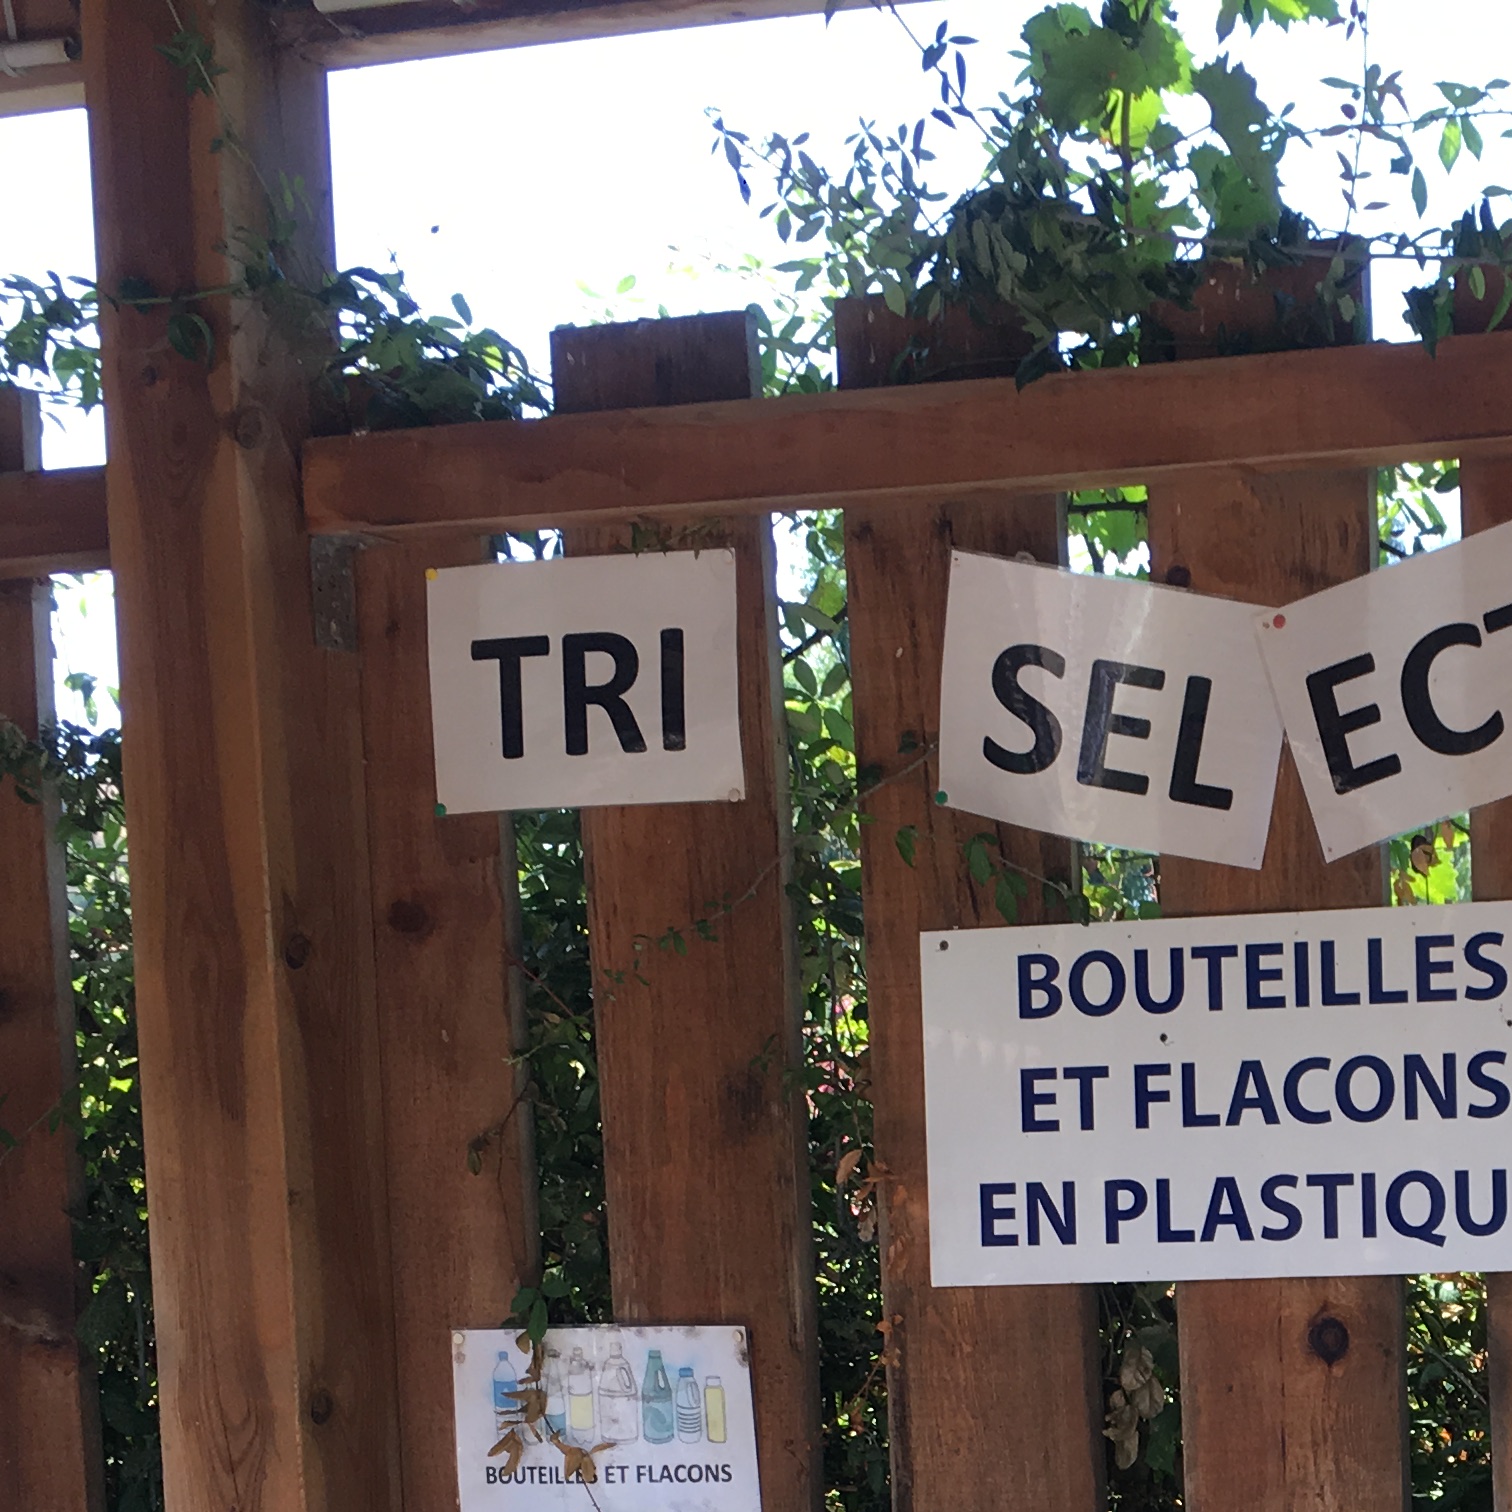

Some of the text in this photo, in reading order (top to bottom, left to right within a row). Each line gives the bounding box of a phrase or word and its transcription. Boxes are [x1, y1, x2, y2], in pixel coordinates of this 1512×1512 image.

[471, 628, 686, 759] TRI
[1017, 931, 1508, 1020] BOUTEILLES
[1020, 1050, 1511, 1133] ET FLACONS
[979, 1180, 1077, 1247] EN
[605, 1465, 629, 1484] ET
[636, 1464, 733, 1484] FLACONS
